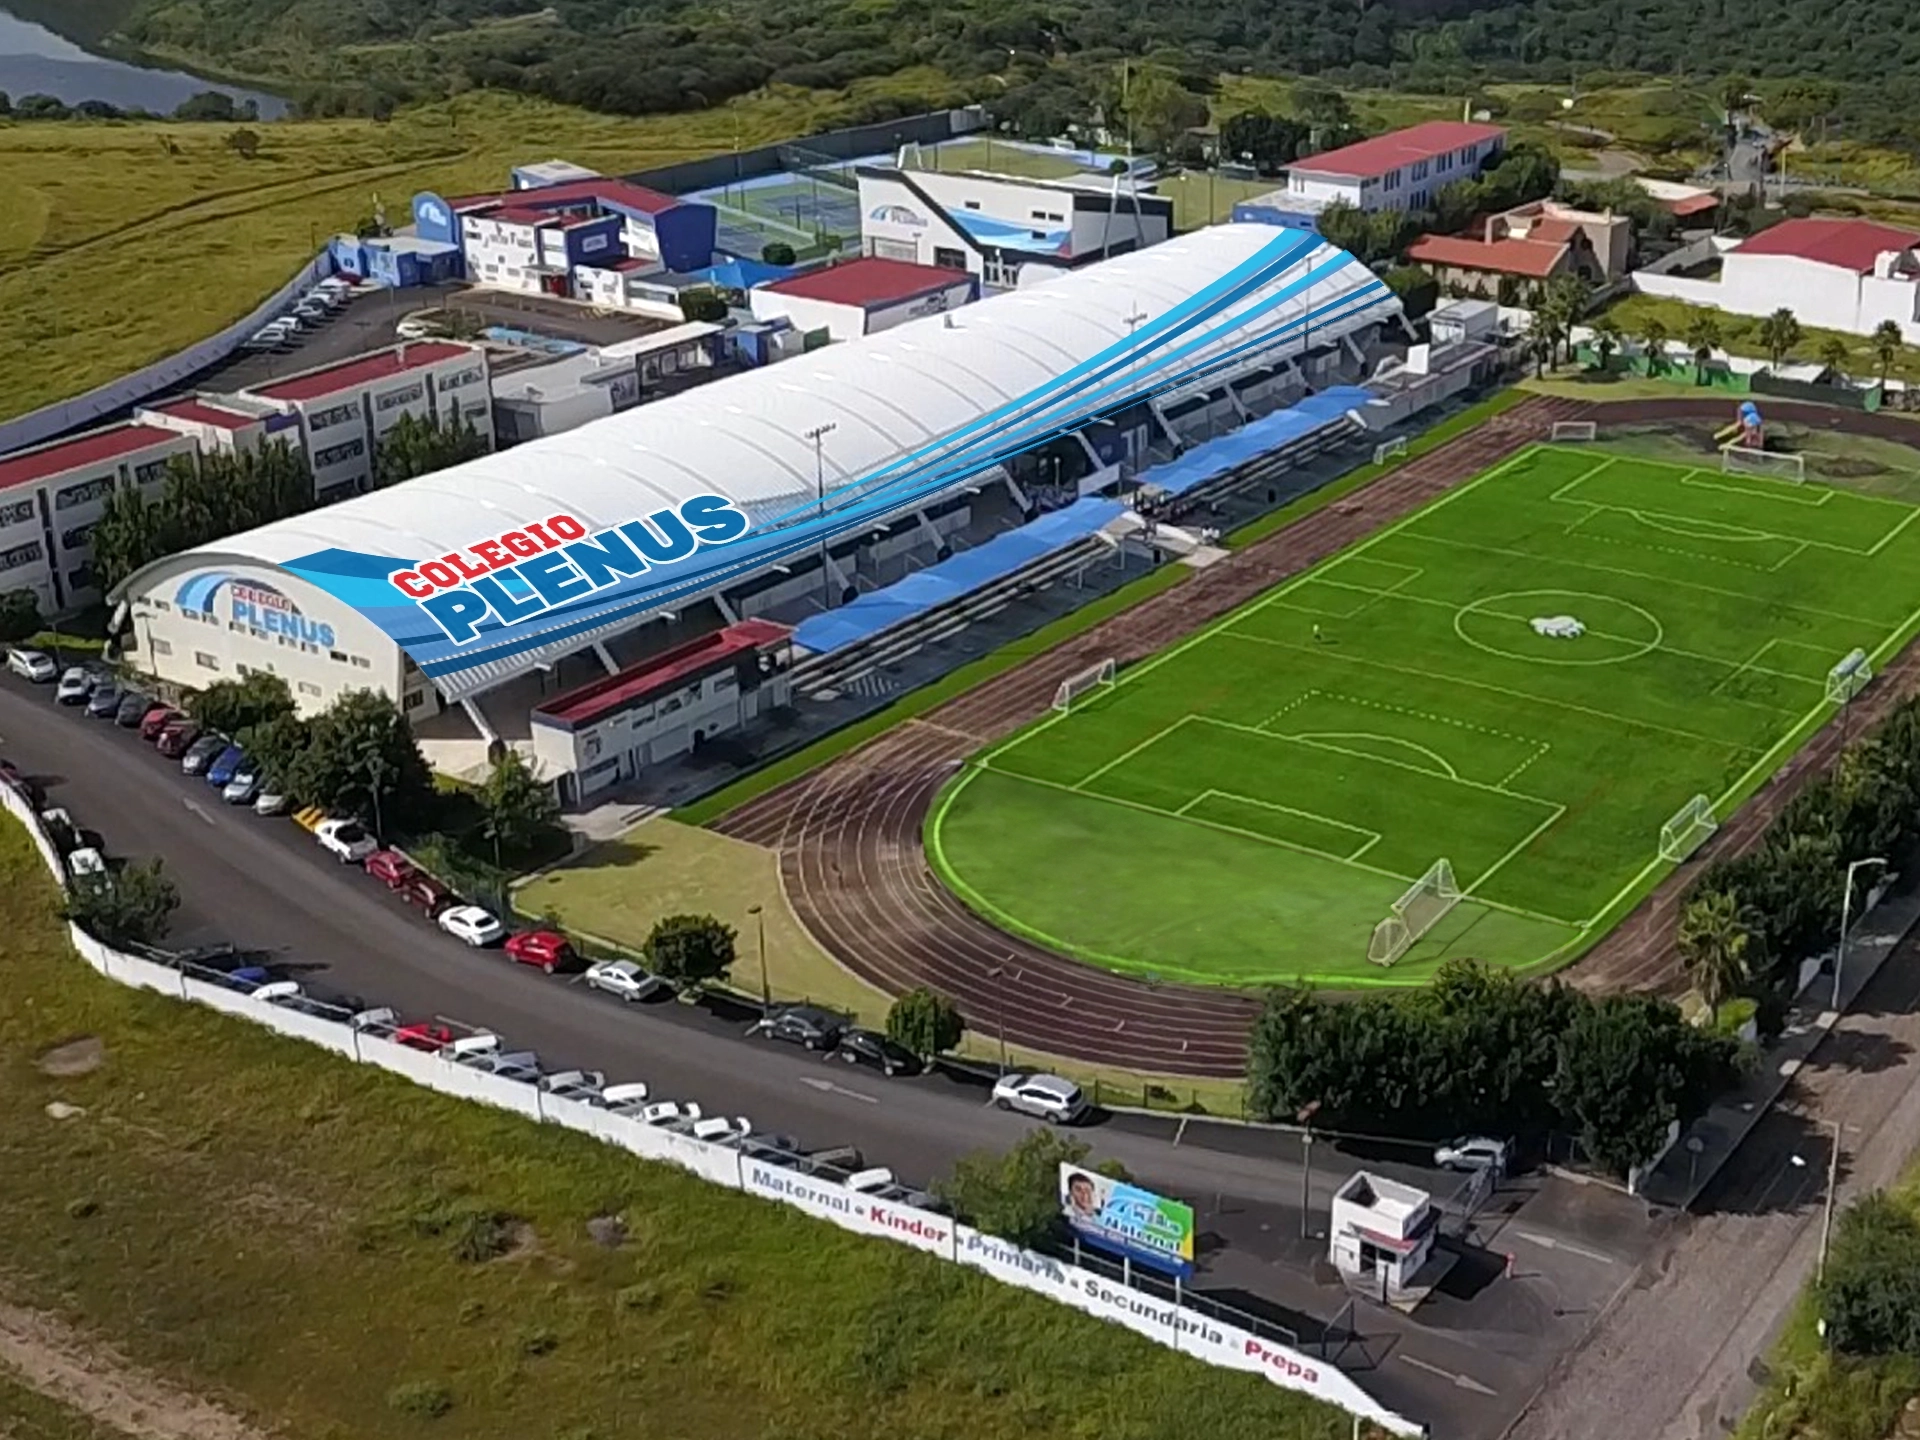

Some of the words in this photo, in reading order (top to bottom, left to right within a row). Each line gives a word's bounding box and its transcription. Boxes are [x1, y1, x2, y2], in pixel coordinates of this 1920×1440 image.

[391, 513, 588, 599] COLEGIO
[418, 494, 749, 645] PLENUS
[232, 600, 336, 648] PLENUS
[752, 1168, 850, 1214] Maternal
[870, 1205, 949, 1243] Kinder
[1084, 1279, 1223, 1345] Secundaria
[1245, 1339, 1319, 1384] Prepa
